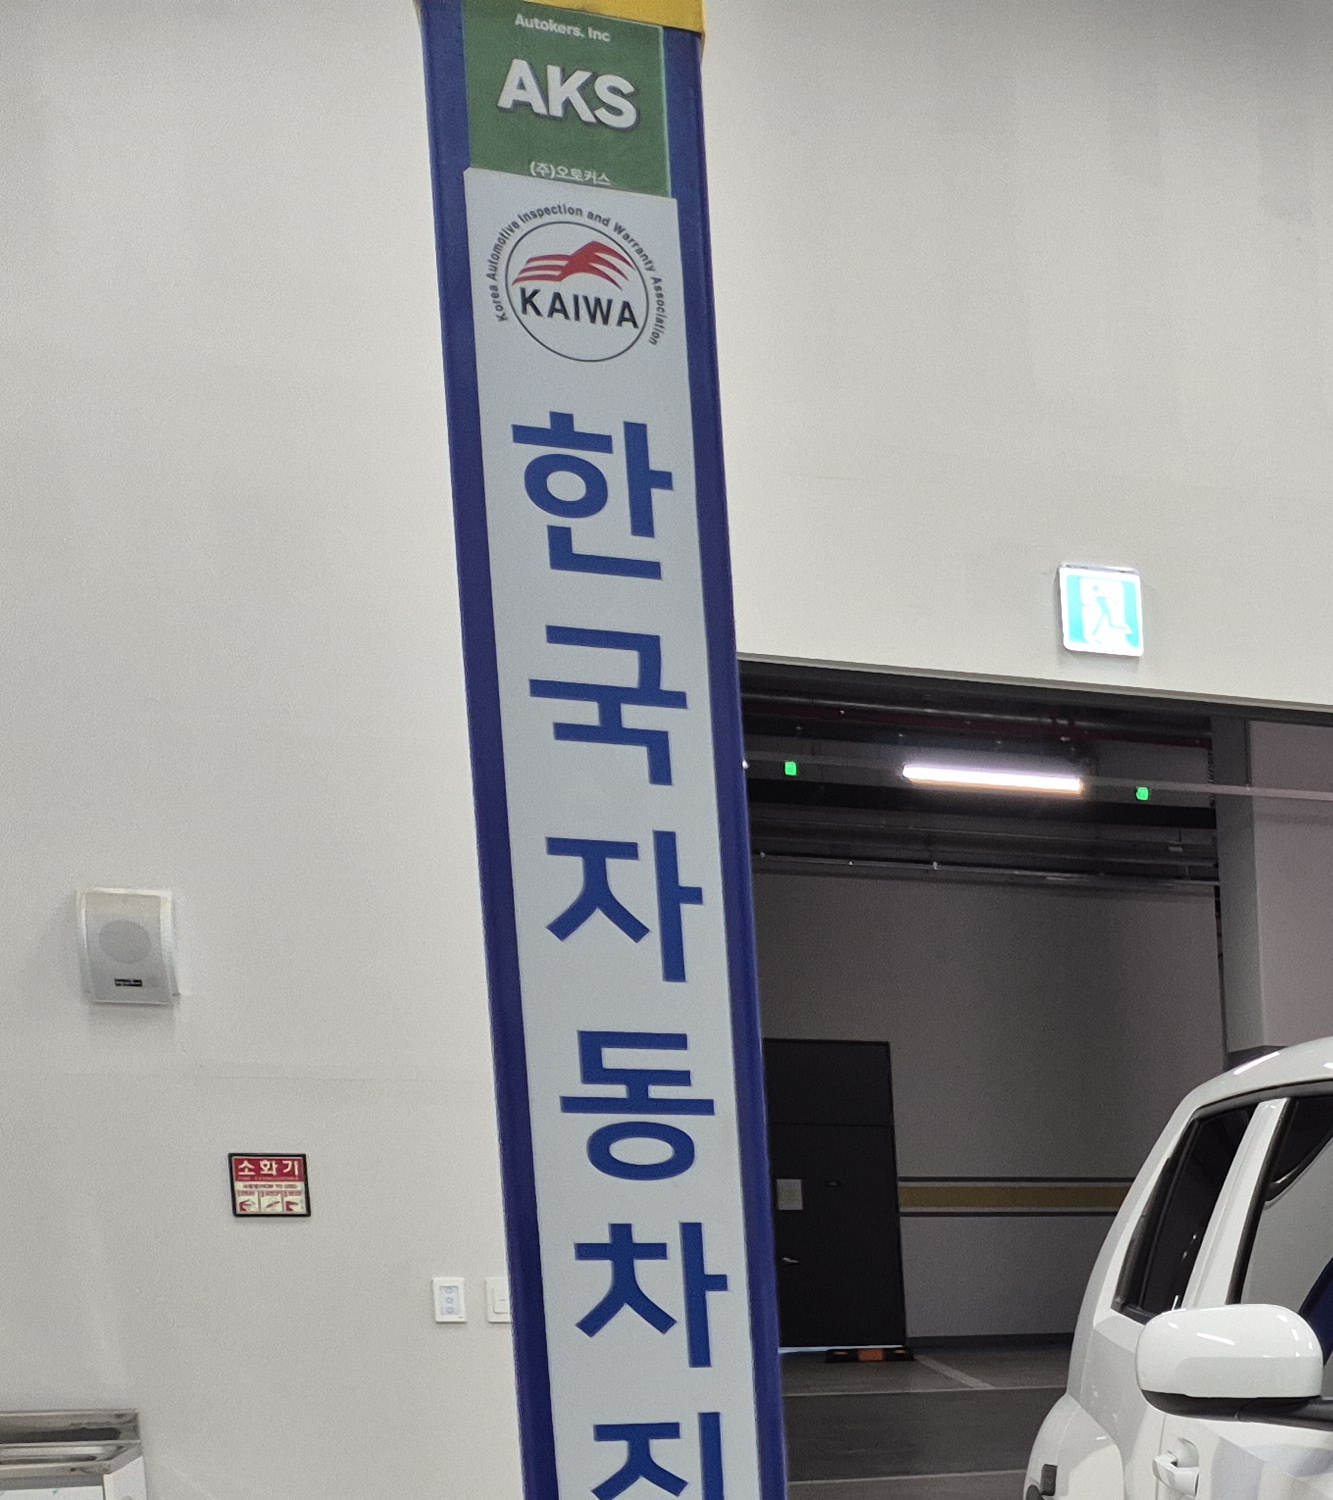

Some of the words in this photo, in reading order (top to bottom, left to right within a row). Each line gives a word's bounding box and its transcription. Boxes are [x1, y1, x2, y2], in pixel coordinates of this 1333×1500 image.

[588, 27, 611, 42] Inc
[497, 58, 638, 129] AKS
[529, 161, 612, 186] (주)오토커스
[520, 204, 583, 224] Inspection
[587, 210, 611, 227] and
[485, 219, 520, 281] Automotive
[612, 222, 657, 272] Warranty
[490, 285, 508, 322] Korea
[519, 286, 639, 329] KAIWA
[648, 276, 667, 346] Association
